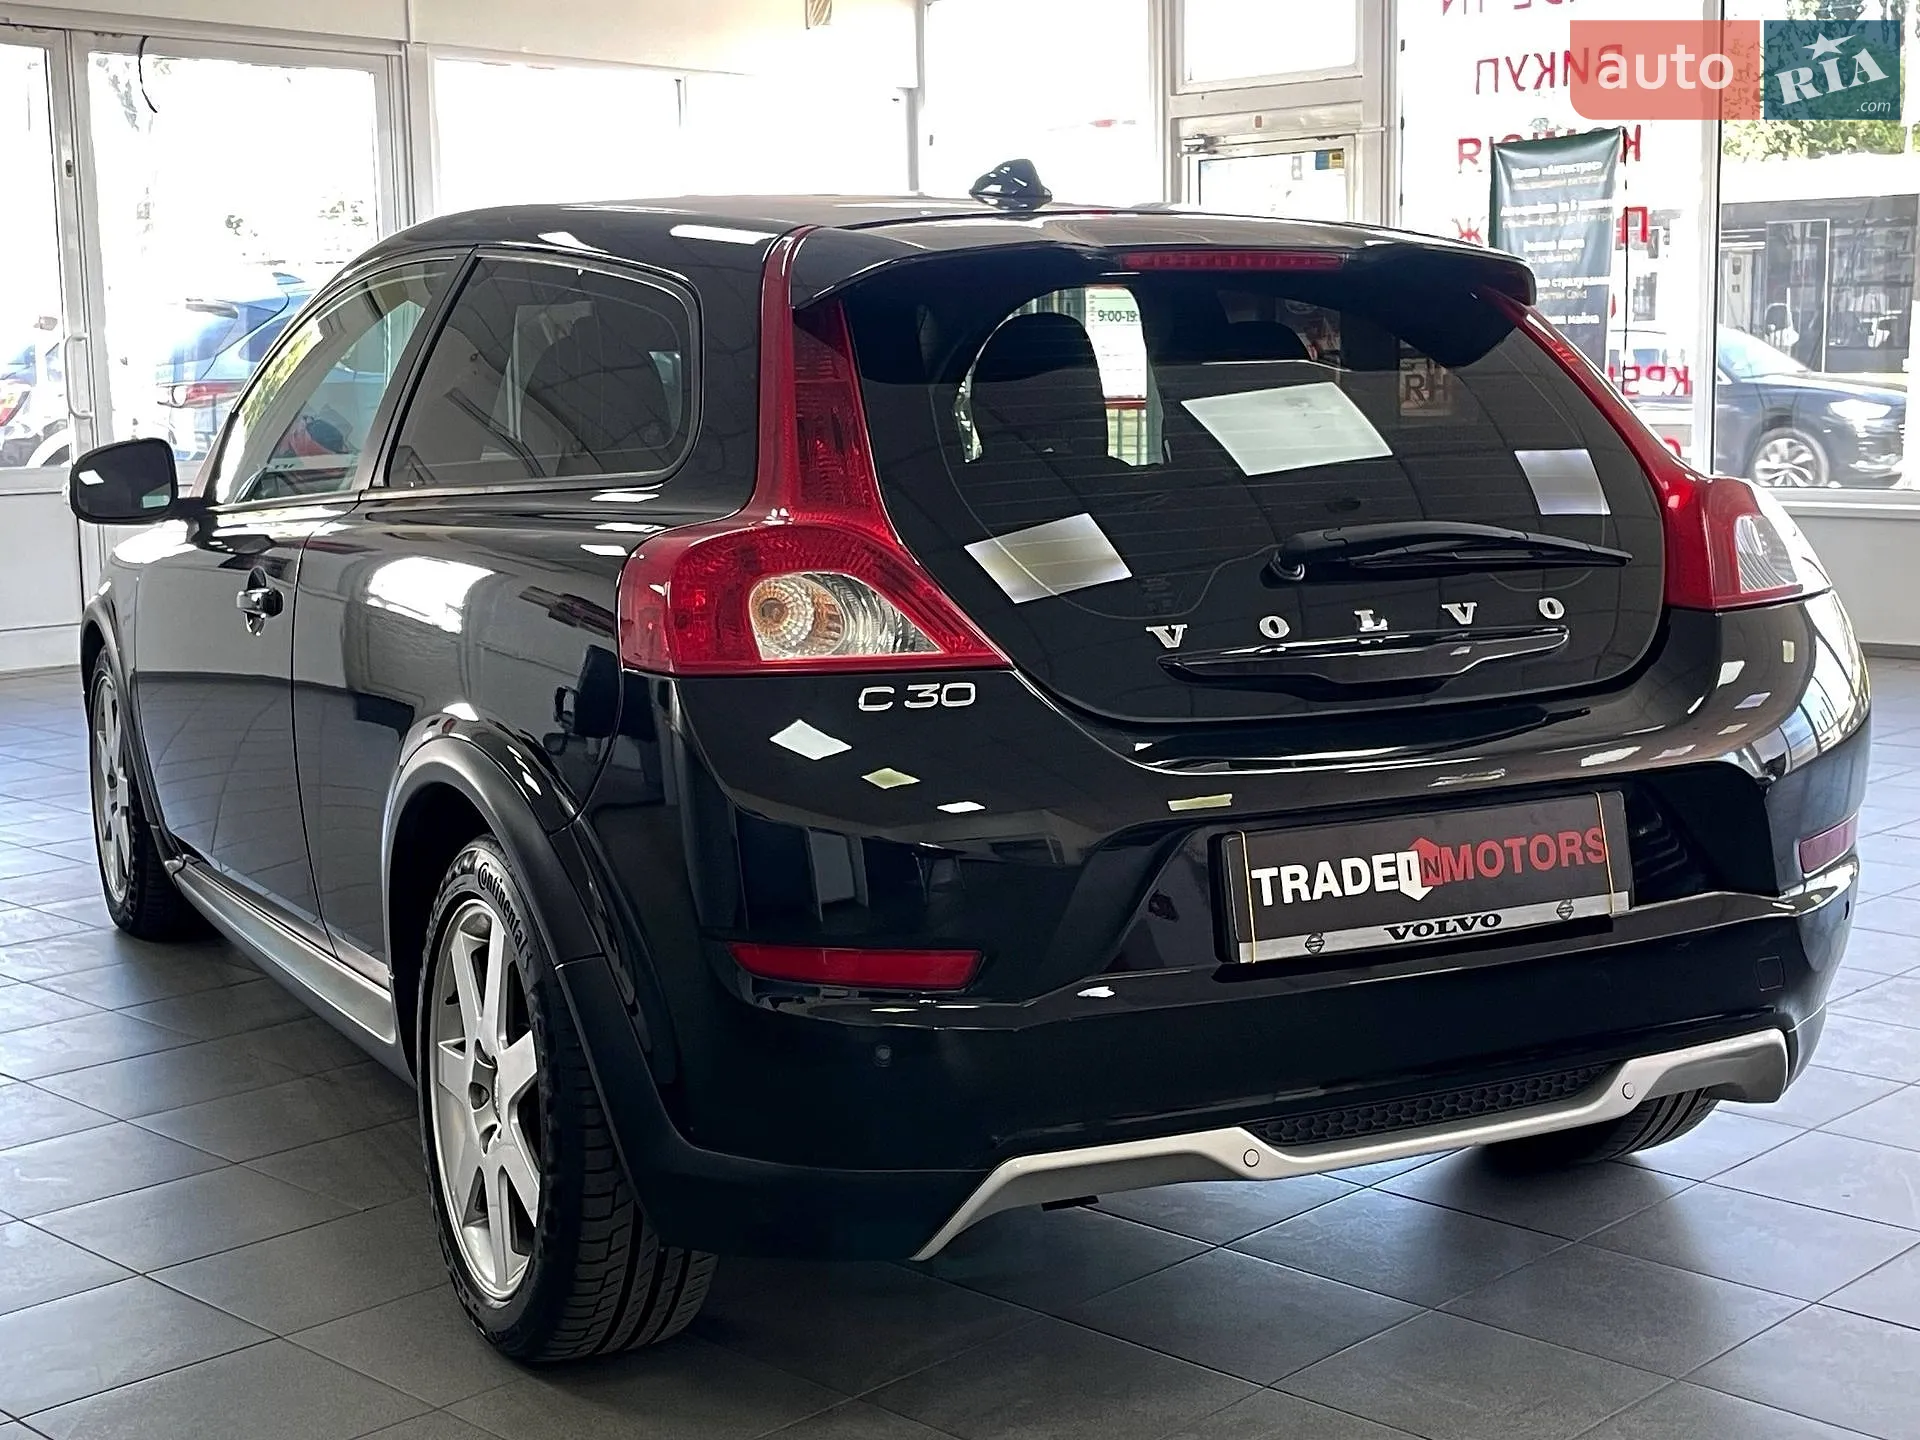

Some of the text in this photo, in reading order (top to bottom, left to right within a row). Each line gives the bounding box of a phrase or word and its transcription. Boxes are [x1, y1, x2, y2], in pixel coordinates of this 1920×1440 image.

[1145, 597, 1565, 649] VOLVO
[1251, 851, 1400, 906] TRADE
[477, 861, 529, 952] Continental
[1384, 913, 1502, 941] VOLVO
